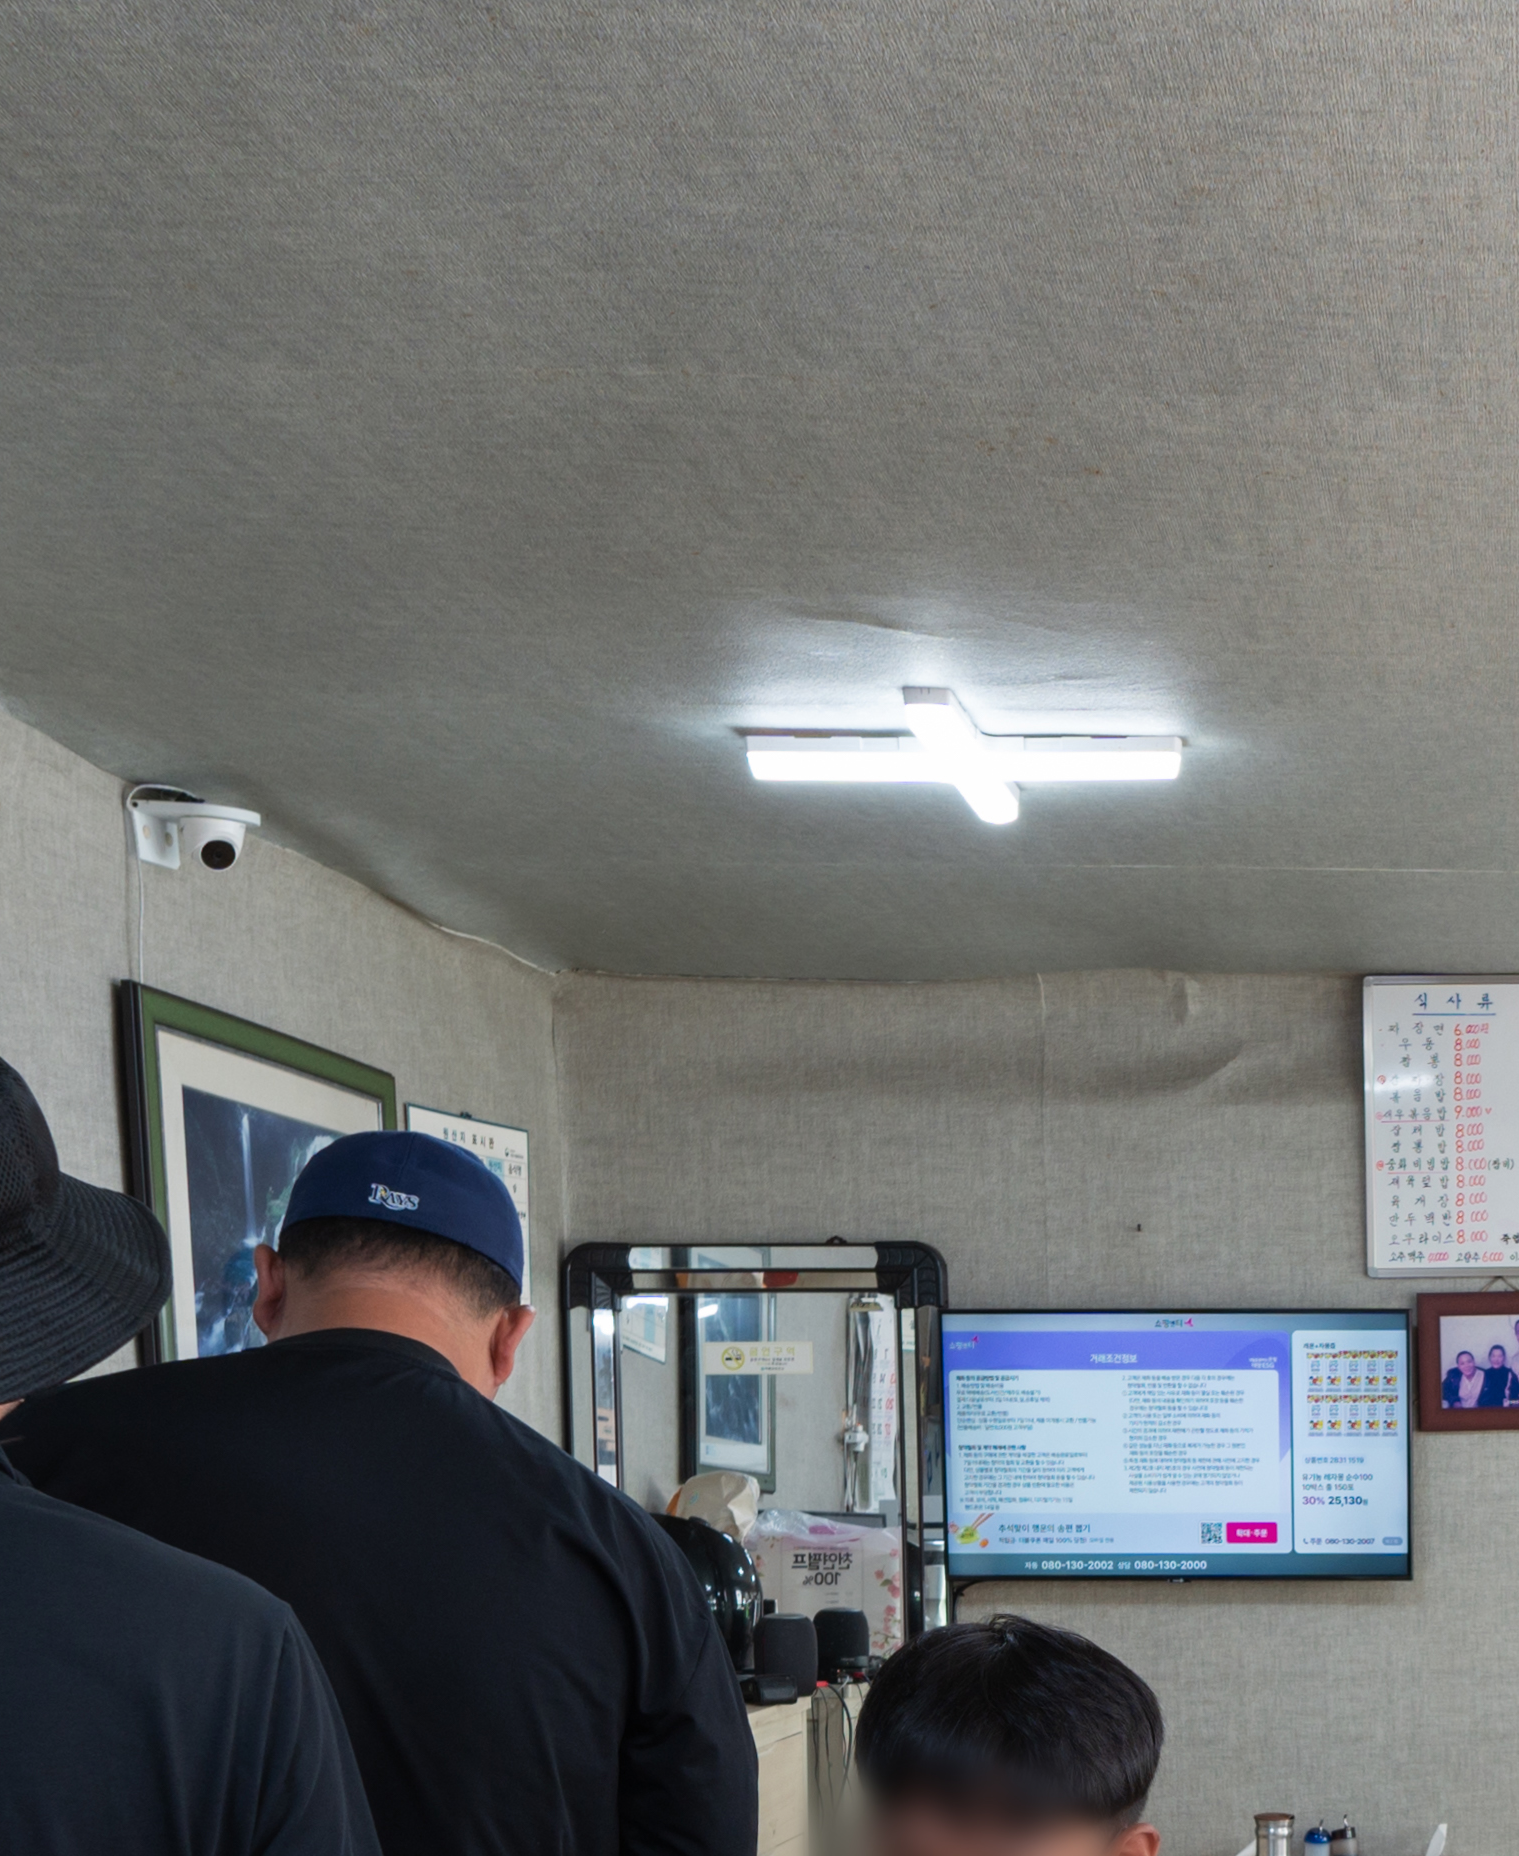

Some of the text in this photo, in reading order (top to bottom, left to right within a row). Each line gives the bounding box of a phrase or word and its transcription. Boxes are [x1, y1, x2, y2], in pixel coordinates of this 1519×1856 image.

[1414, 992, 1493, 1010] 식사류
[1388, 1021, 1444, 1036] 짜장면
[1398, 1037, 1435, 1051] 우동
[443, 1127, 495, 1149] 원산지 표시판
[1391, 1193, 1449, 1209] 육개장
[1389, 1210, 1452, 1227] 만두백반
[1089, 1354, 1138, 1364] 거래조건정보
[1302, 1473, 1322, 1481] 유기농
[1302, 1496, 1325, 1505] 30%
[1041, 1561, 1114, 1570] 080-130-2002
[1134, 1560, 1207, 1570] 080-130-2000
